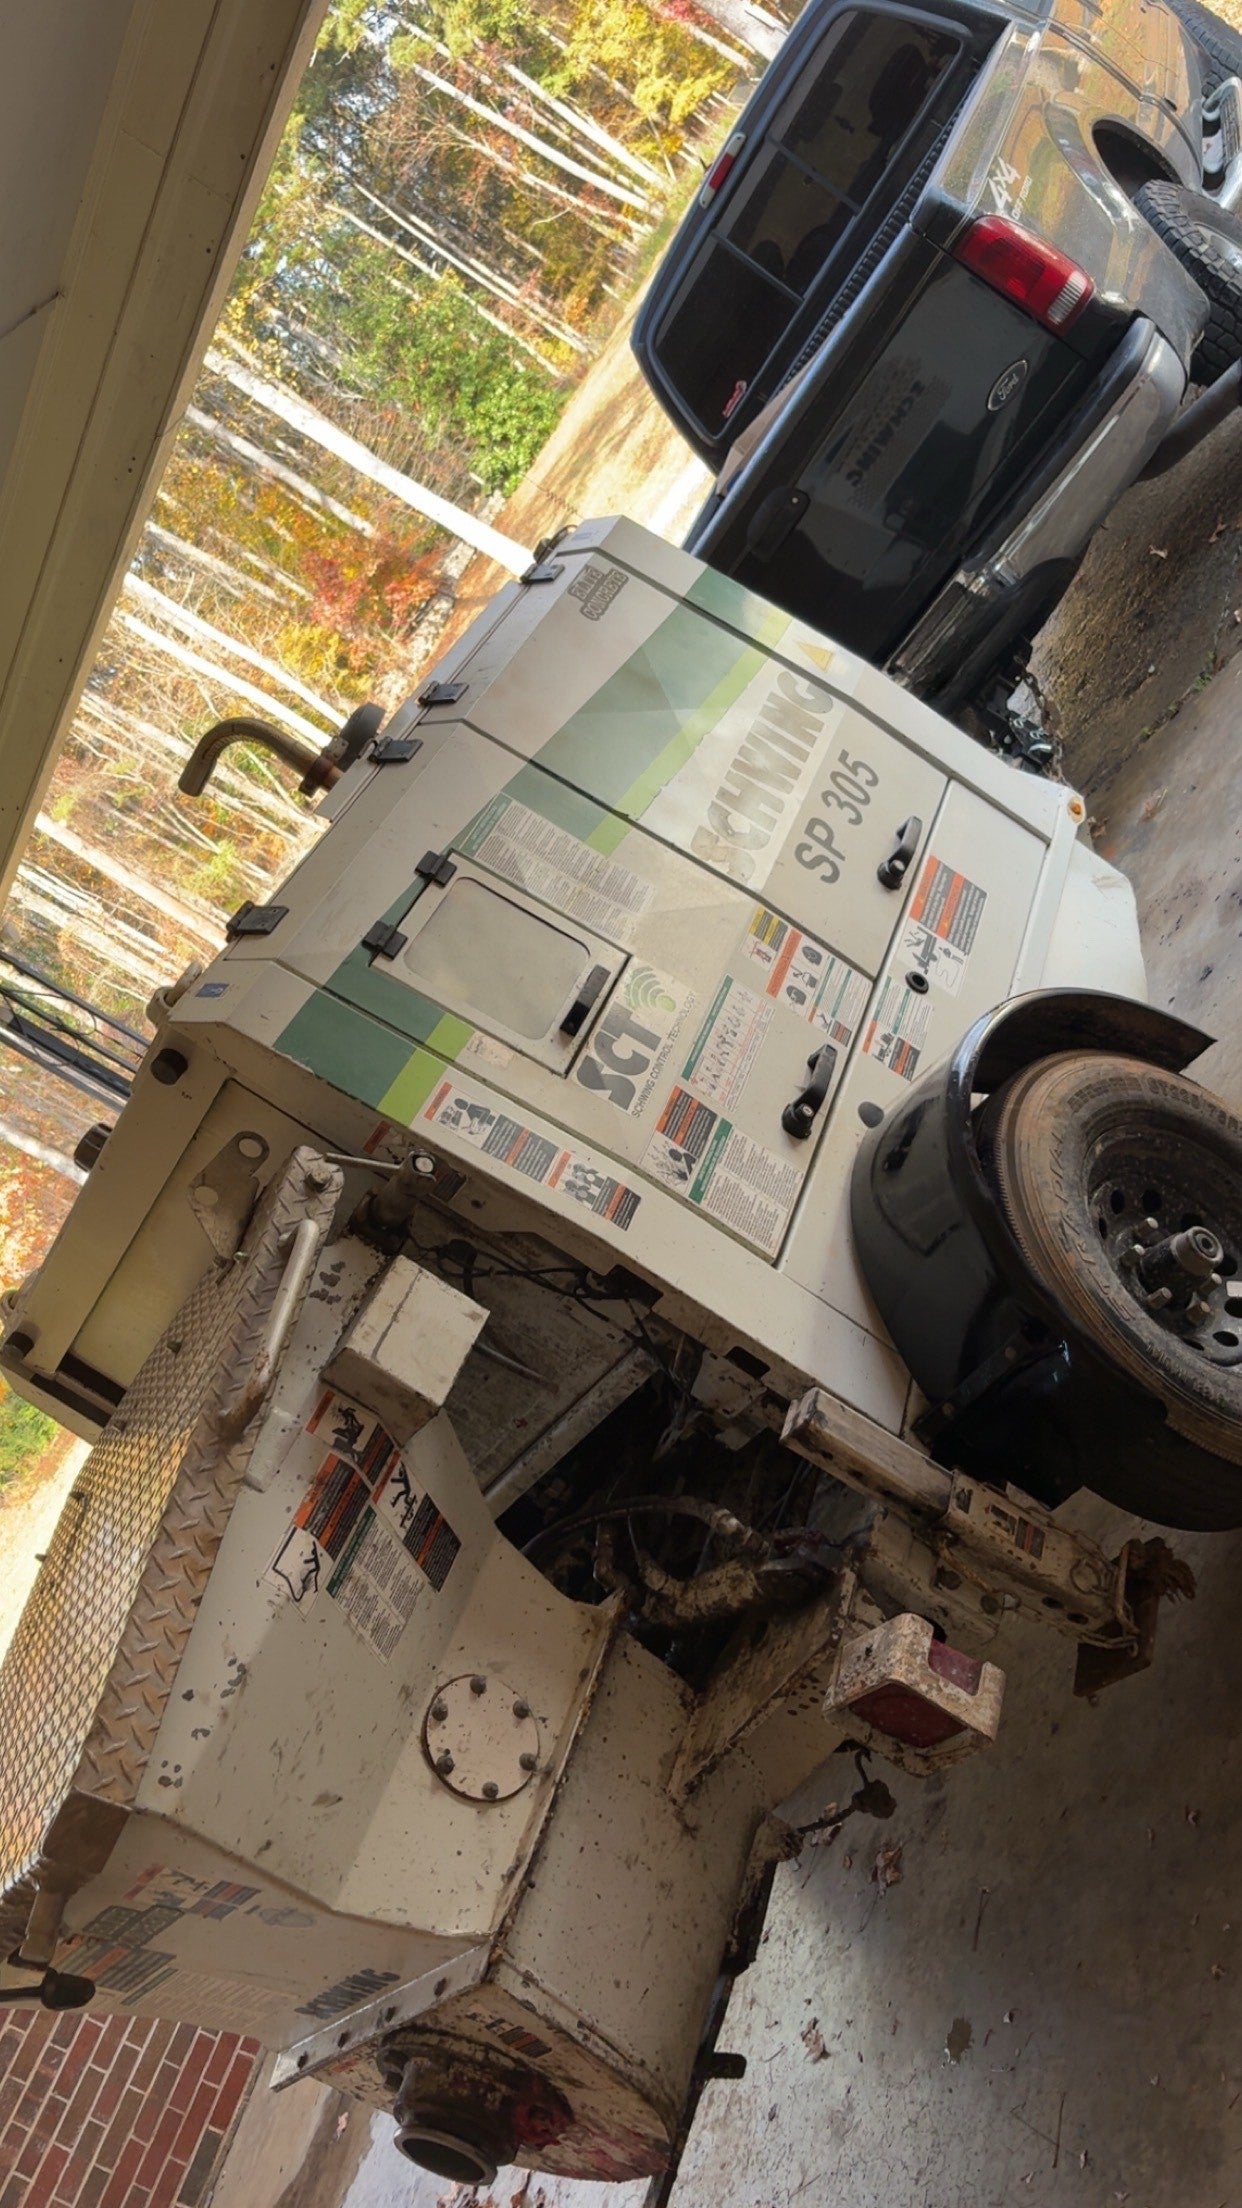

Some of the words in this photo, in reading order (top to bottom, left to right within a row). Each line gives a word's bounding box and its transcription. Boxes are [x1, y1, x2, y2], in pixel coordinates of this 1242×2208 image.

[584, 569, 626, 619] CONCRETE
[691, 673, 834, 884] SCHWING
[794, 817, 846, 884] SP
[820, 749, 880, 826] 305
[577, 1001, 661, 1110] SCT
[632, 1078, 655, 1117] SCHWING
[650, 1041, 673, 1080] CONTROL
[668, 991, 696, 1042] TECHNOLOGY
